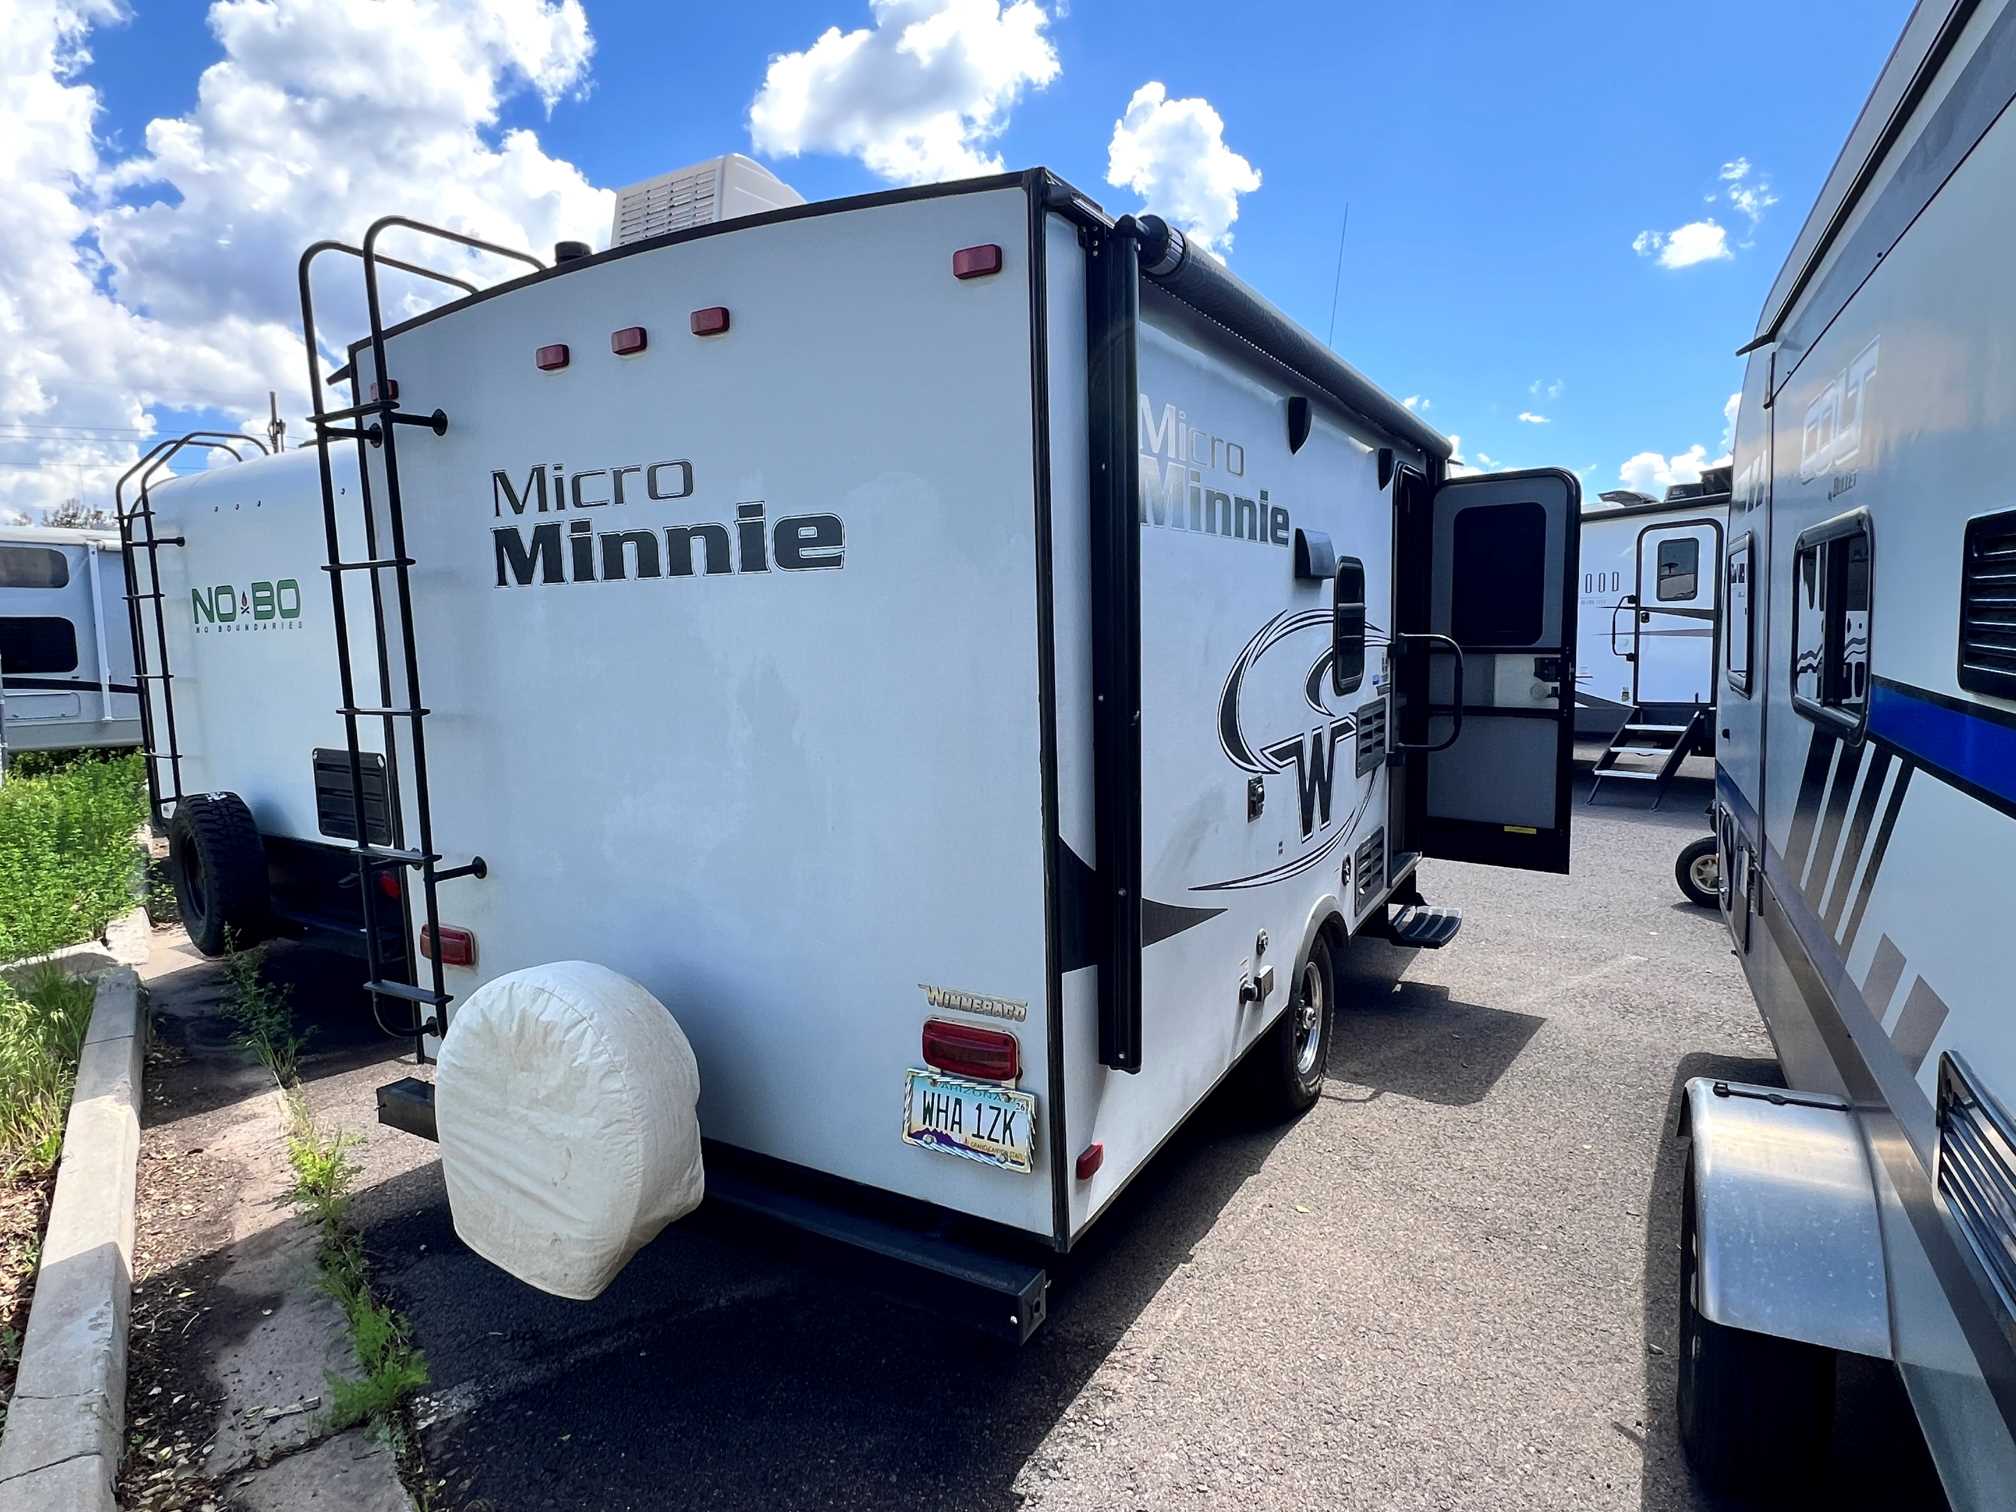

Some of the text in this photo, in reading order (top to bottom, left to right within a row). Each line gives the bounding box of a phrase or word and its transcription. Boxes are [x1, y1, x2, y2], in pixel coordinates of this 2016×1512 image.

[1139, 393, 1244, 477] Micro
[491, 458, 694, 517] Micro
[1139, 453, 1291, 549] Minnie
[490, 501, 846, 588] Minnie
[191, 579, 300, 624] NO BO
[195, 621, 303, 634] NO BOUNDARIES
[922, 1091, 1015, 1147] WHA 1ZK
[1015, 1102, 1025, 1112] 26
